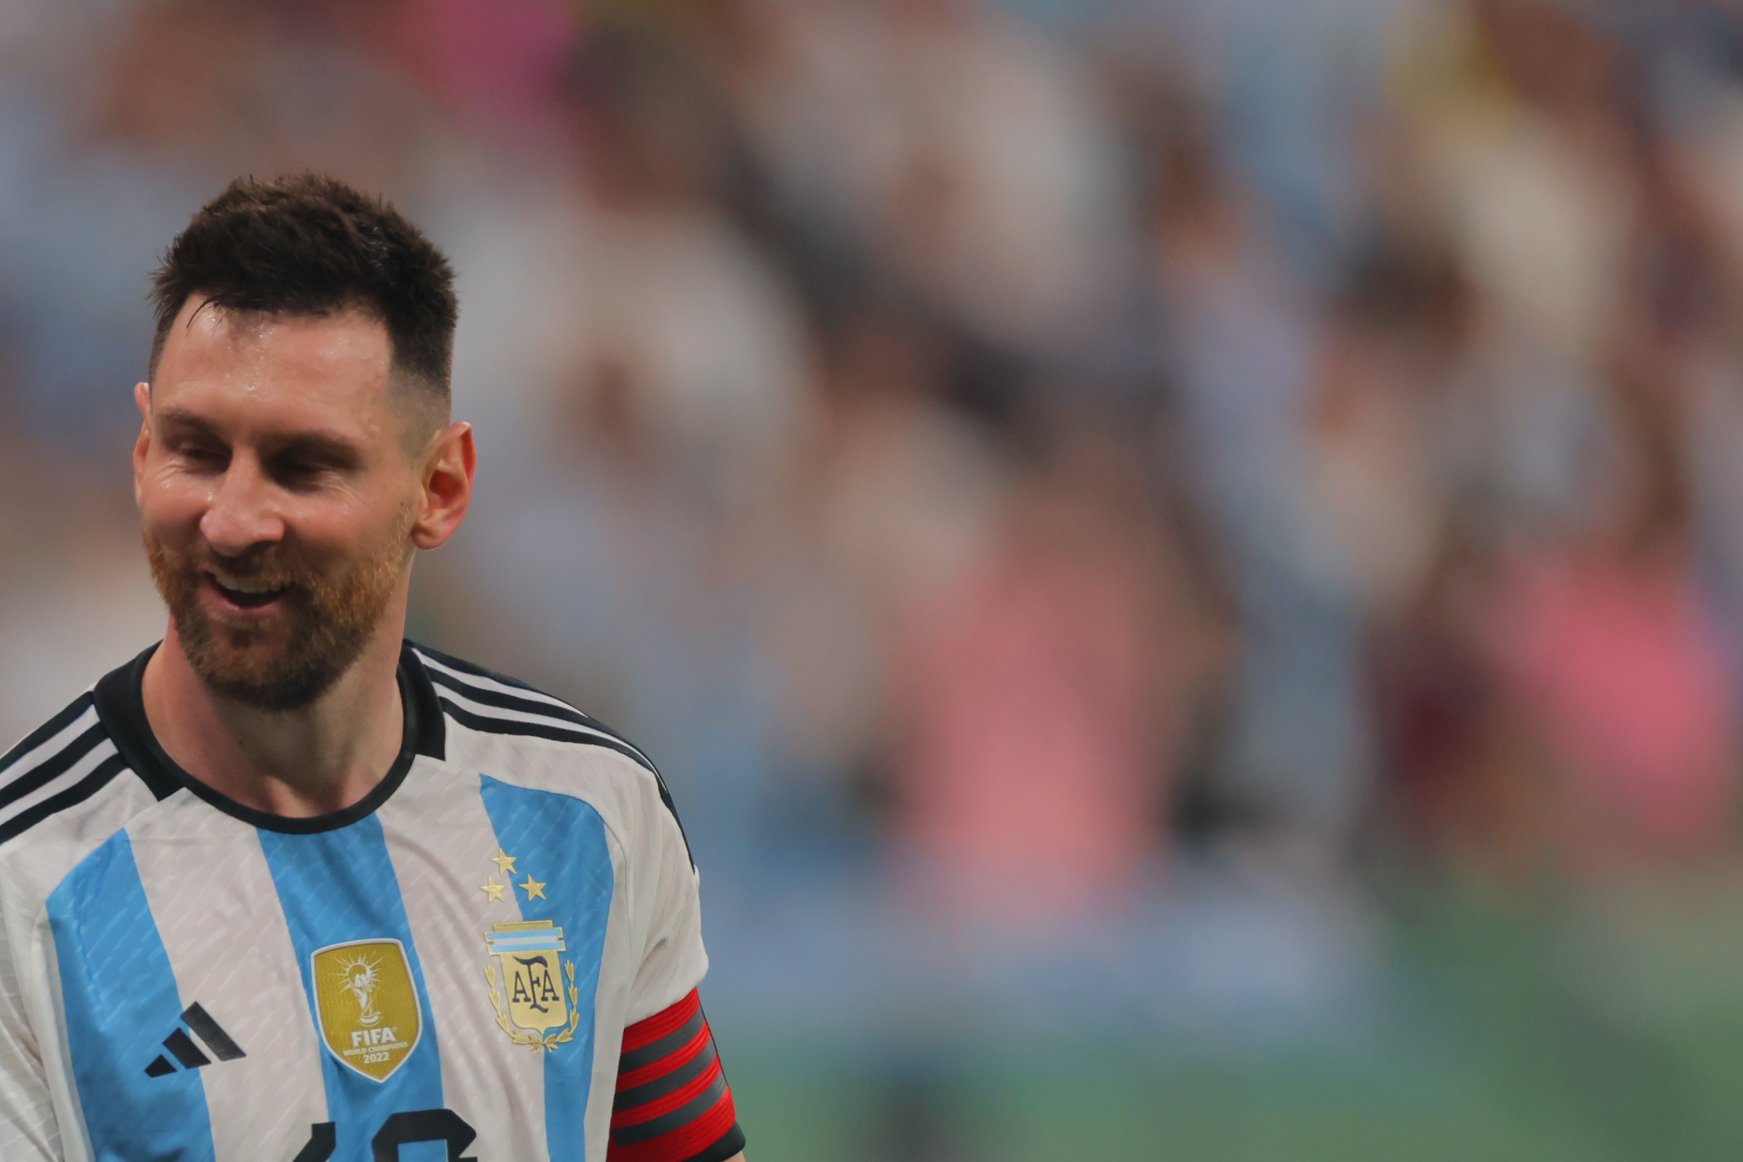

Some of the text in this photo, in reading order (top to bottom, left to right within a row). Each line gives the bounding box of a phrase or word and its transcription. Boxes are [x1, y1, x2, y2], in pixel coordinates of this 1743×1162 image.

[511, 954, 560, 1014] AFA
[351, 1027, 396, 1047] FIFA
[363, 1052, 390, 1064] 2022
